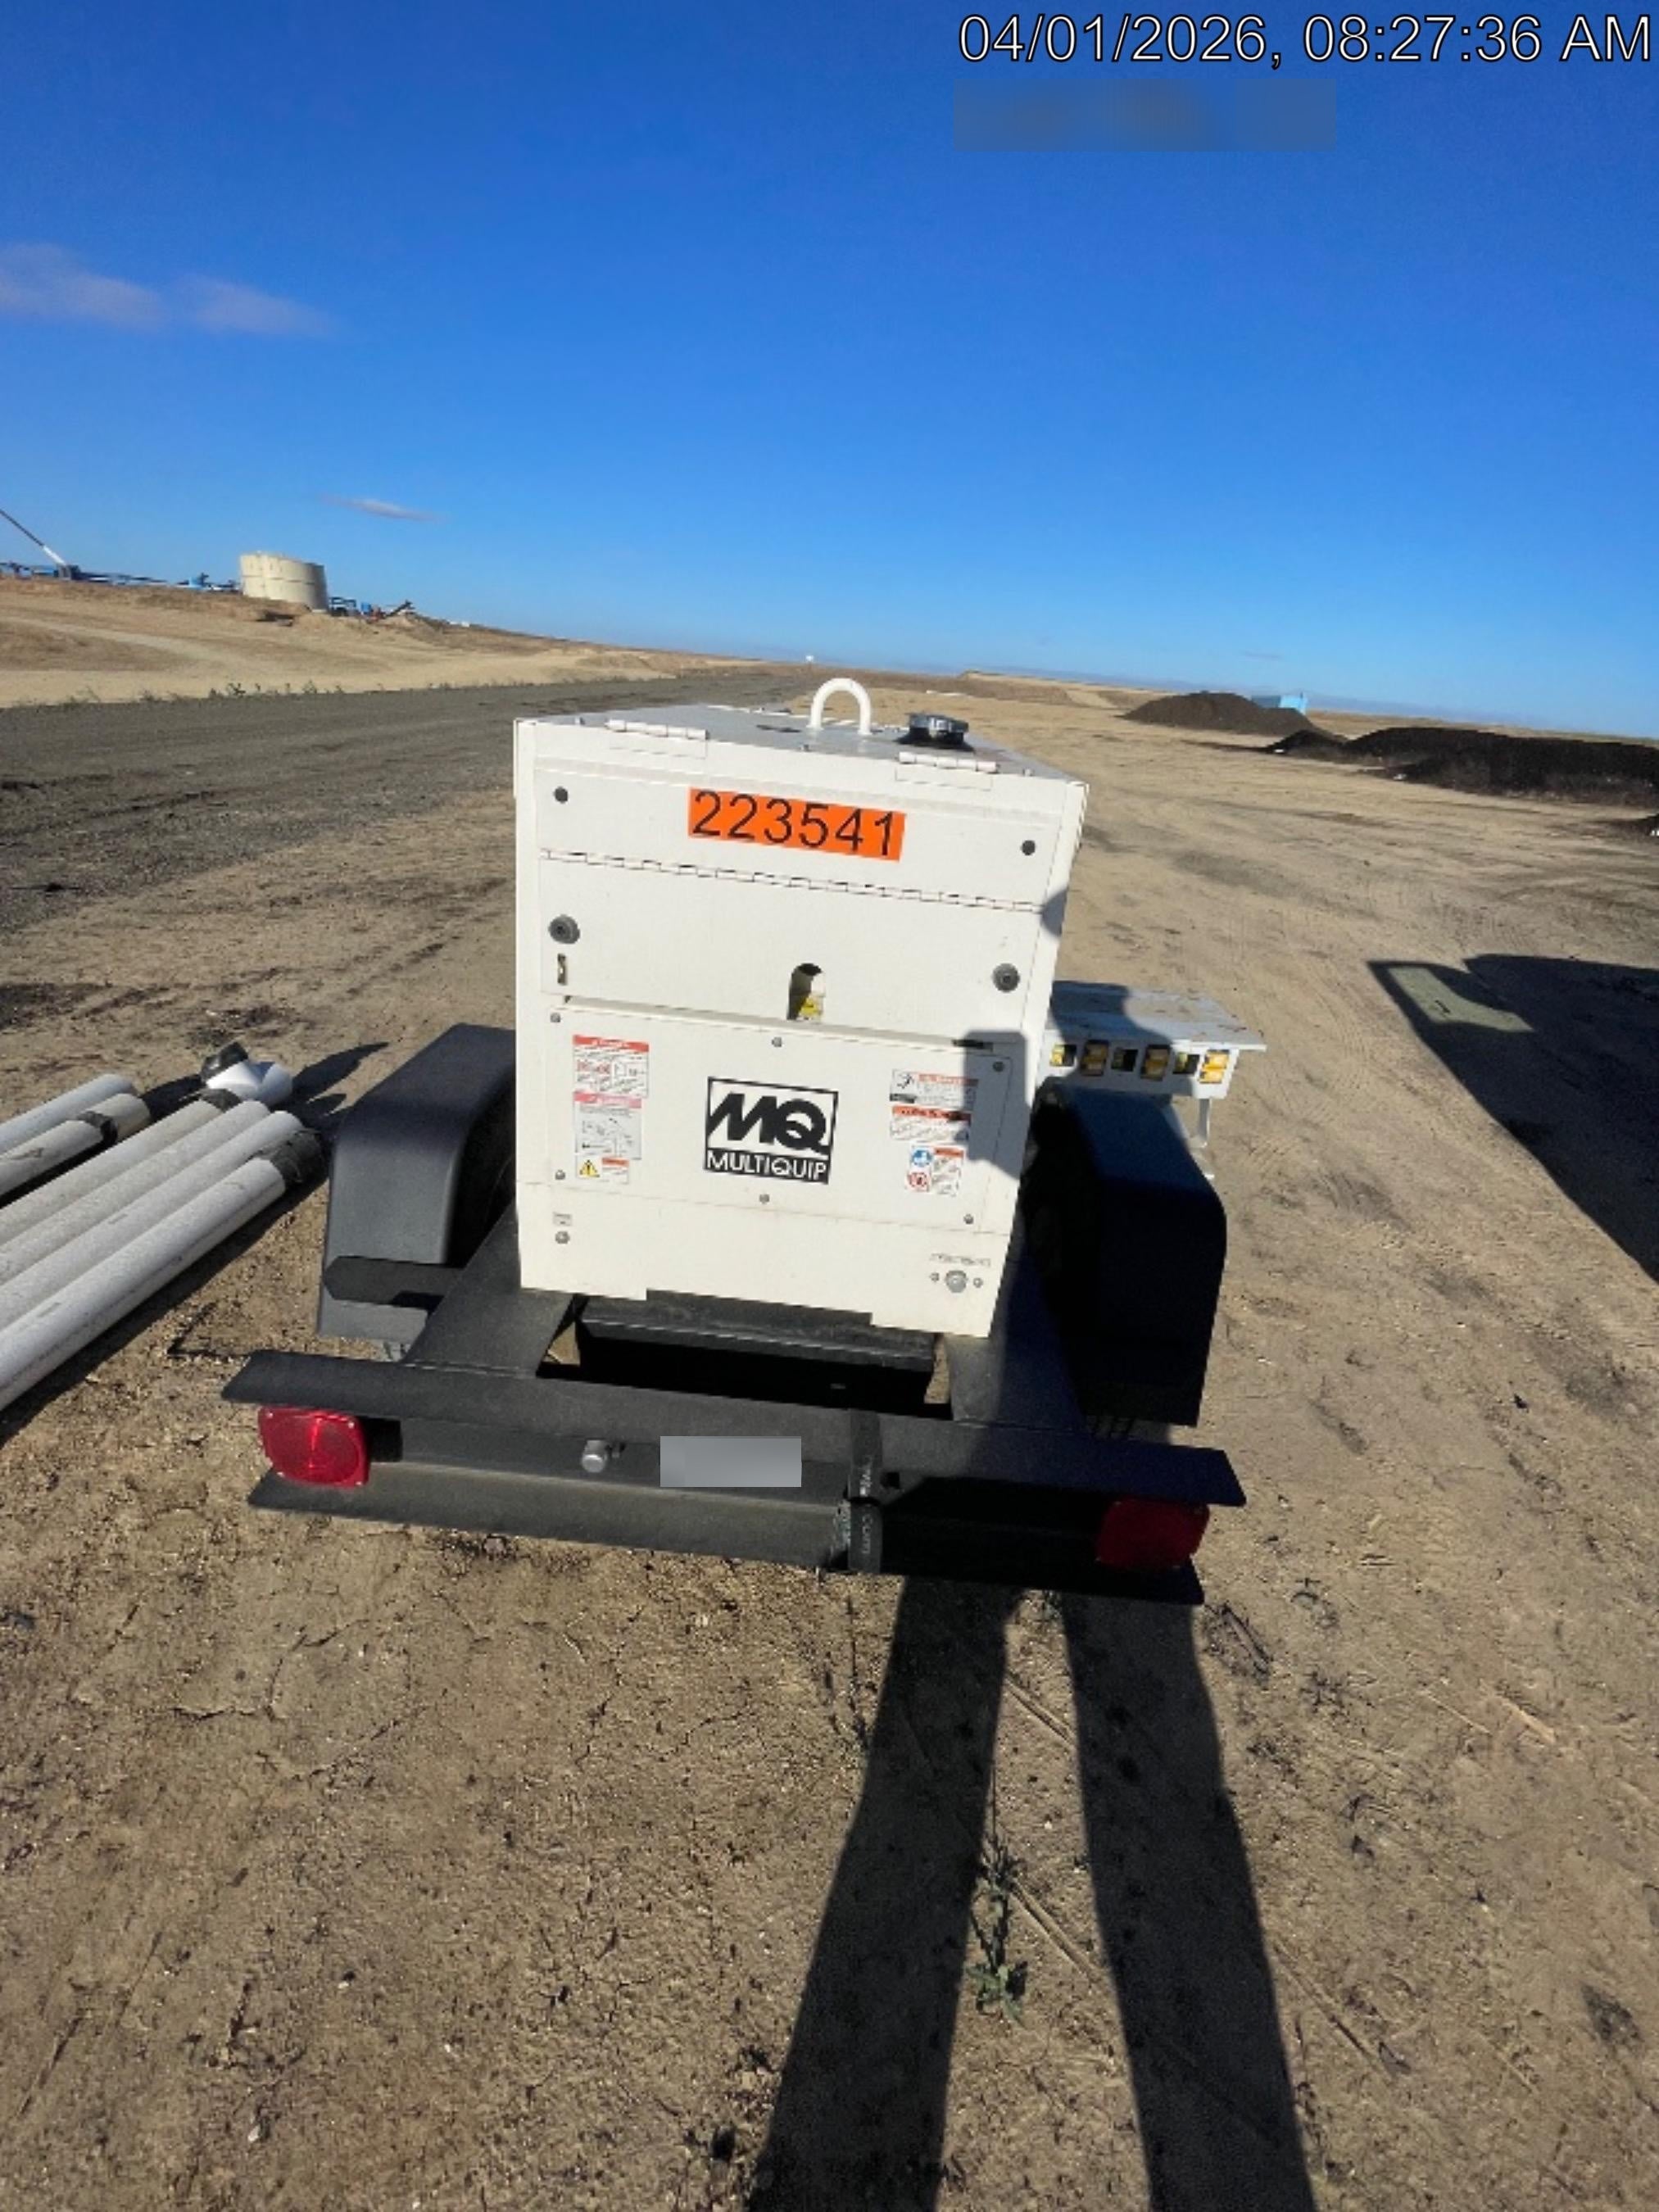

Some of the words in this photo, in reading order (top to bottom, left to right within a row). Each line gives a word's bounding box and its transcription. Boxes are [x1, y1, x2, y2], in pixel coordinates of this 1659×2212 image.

[692, 789, 895, 856] 223541
[706, 1092, 831, 1154] MQ
[707, 1149, 827, 1181] MULTIQUIP
